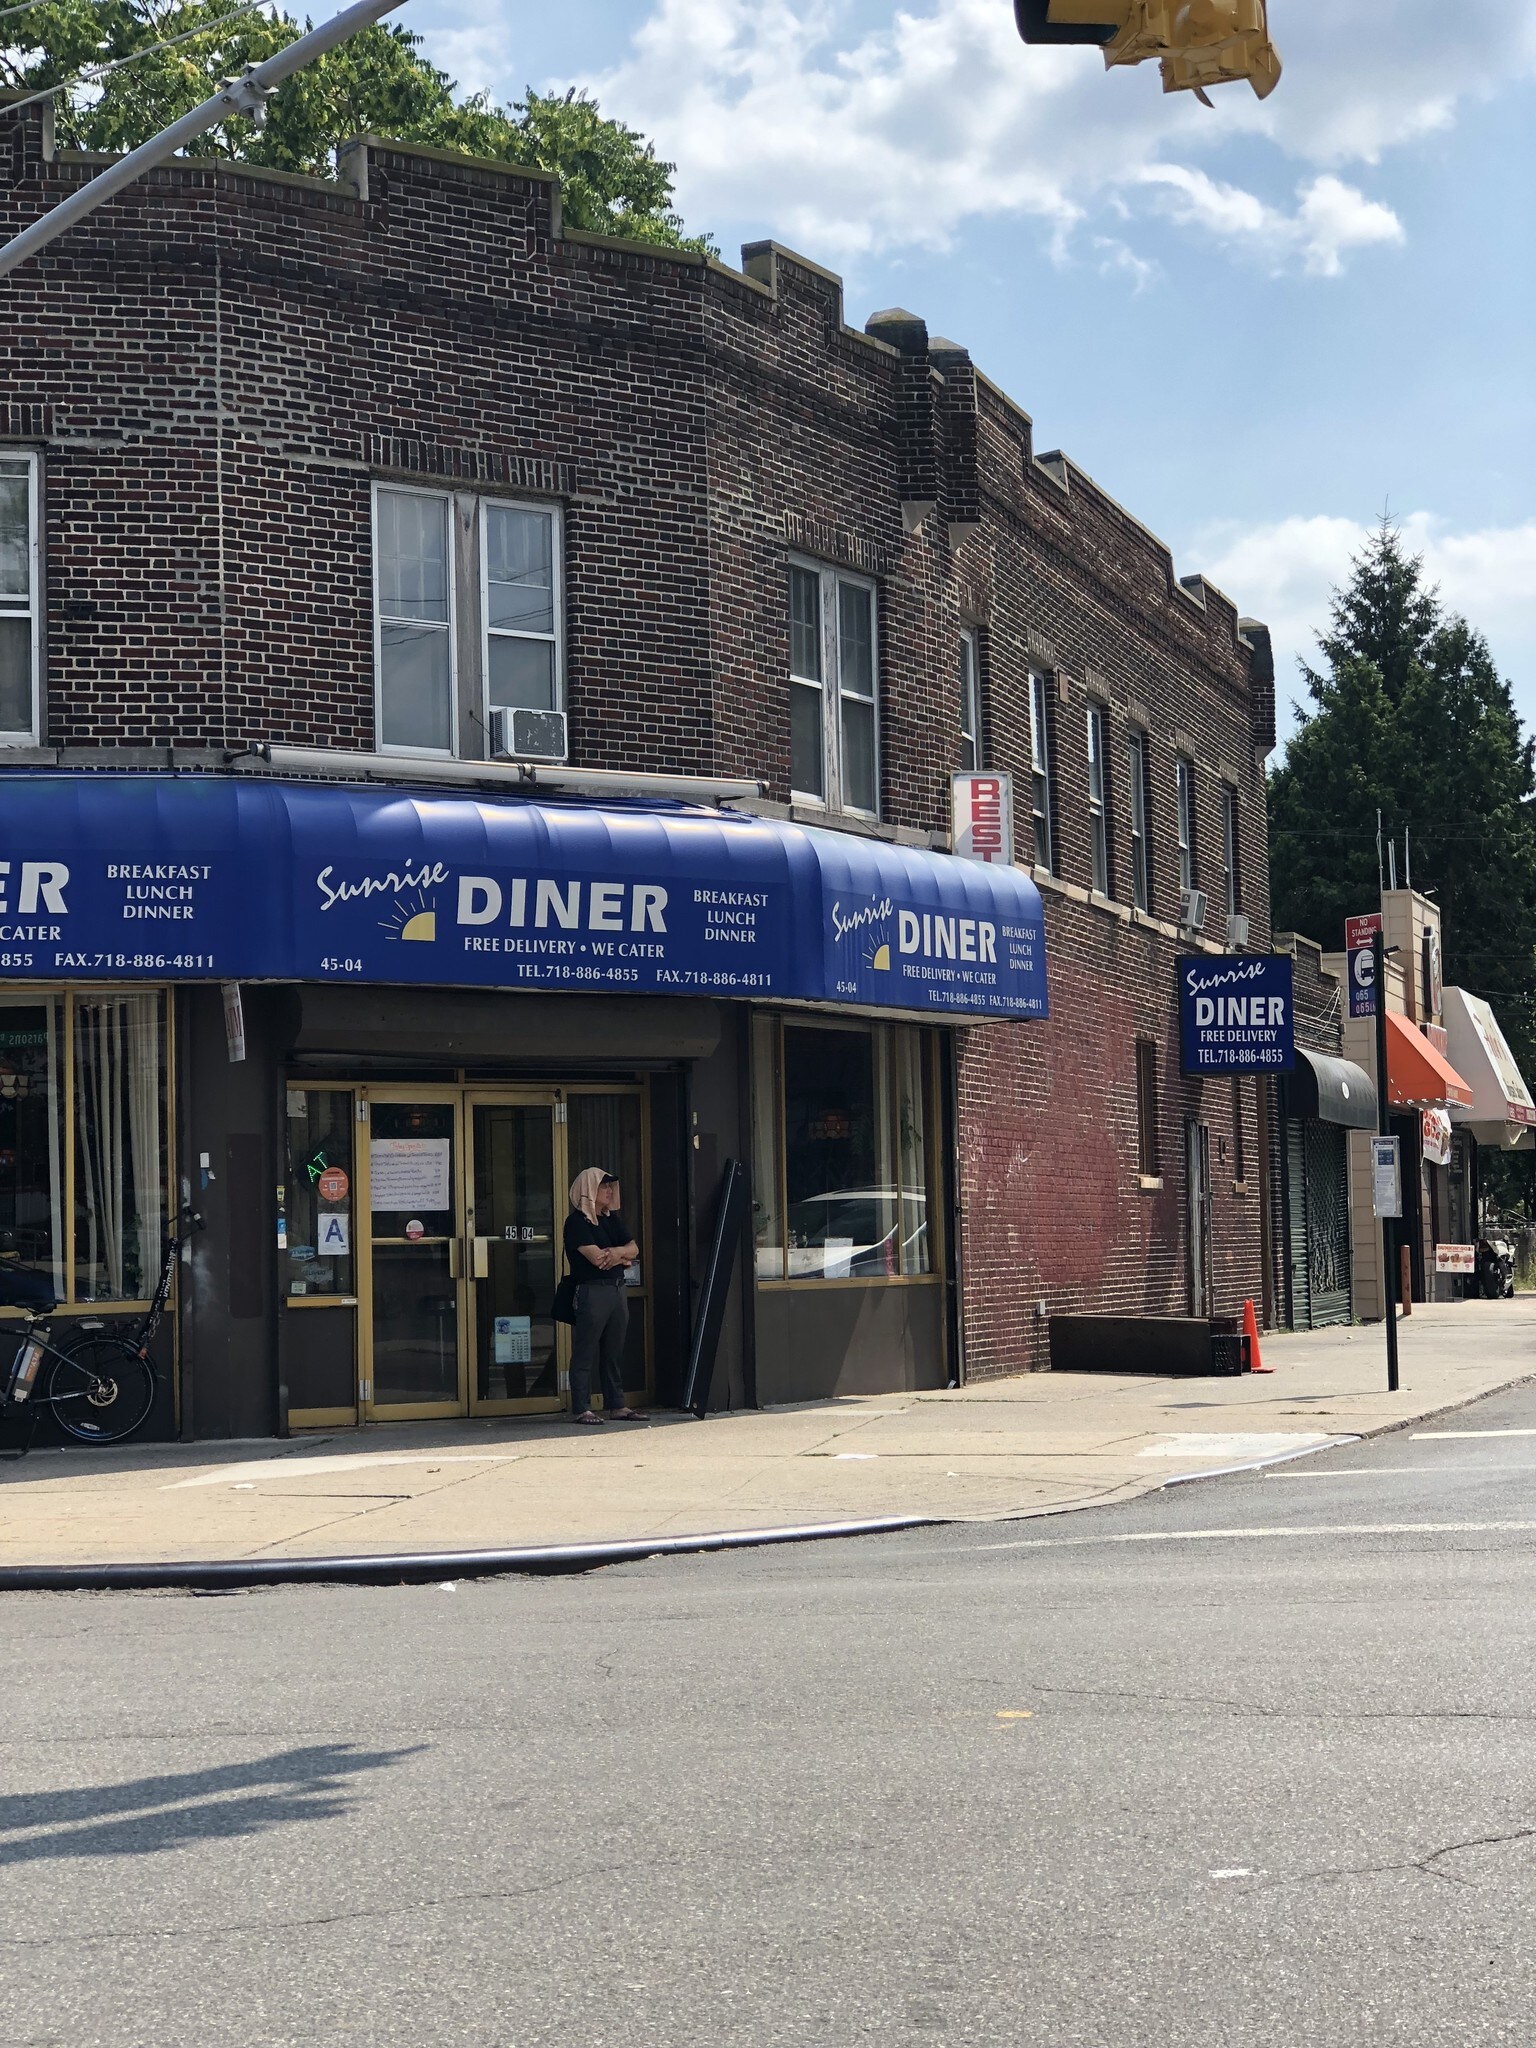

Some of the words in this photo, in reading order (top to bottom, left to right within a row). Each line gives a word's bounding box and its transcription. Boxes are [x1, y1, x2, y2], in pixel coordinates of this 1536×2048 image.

[971, 779, 1001, 862] REST
[107, 865, 212, 880] BREAKFAST
[317, 859, 449, 910] Sunrise
[126, 886, 193, 900] LUNCH
[693, 889, 769, 907] BREAKFAST
[123, 905, 194, 919] DINNER
[457, 876, 668, 933] DINER
[707, 911, 756, 926] LUNCH
[832, 894, 894, 942] Sunrise
[1359, 918, 1368, 927] NO
[0, 926, 61, 940] CATER
[704, 929, 756, 943] DINNER
[899, 910, 997, 963] DINER
[1002, 926, 1037, 941] BREAKFAST
[464, 937, 500, 952] FREE
[504, 939, 576, 955] DELIVERY
[592, 942, 615, 956] WE
[618, 943, 665, 959] CATER
[1009, 943, 1032, 956] LUNCH
[55, 952, 214, 968] FAX.718-886-4811
[320, 958, 363, 972] 45-04
[1010, 959, 1034, 972] DINNER
[516, 964, 639, 982] TEL.718-886-4855
[656, 969, 772, 987] FAX.718-886-4811
[902, 965, 921, 979] FREE
[921, 967, 956, 982] DELIVERY
[962, 970, 974, 983] WE
[974, 972, 997, 985] CATER
[1186, 961, 1266, 996] Sunrise
[836, 981, 857, 994] 45-04
[1355, 989, 1369, 1001] Q65
[928, 989, 986, 1006] TEL.718-886-4855
[989, 995, 1043, 1010] FAX.718-886-4811
[1196, 996, 1285, 1026] DINER
[1200, 1030, 1225, 1042] FREE
[1227, 1030, 1277, 1042] DELIVERY
[325, 1218, 344, 1243] A
[505, 1226, 517, 1239] 45
[522, 1227, 533, 1240] 04
